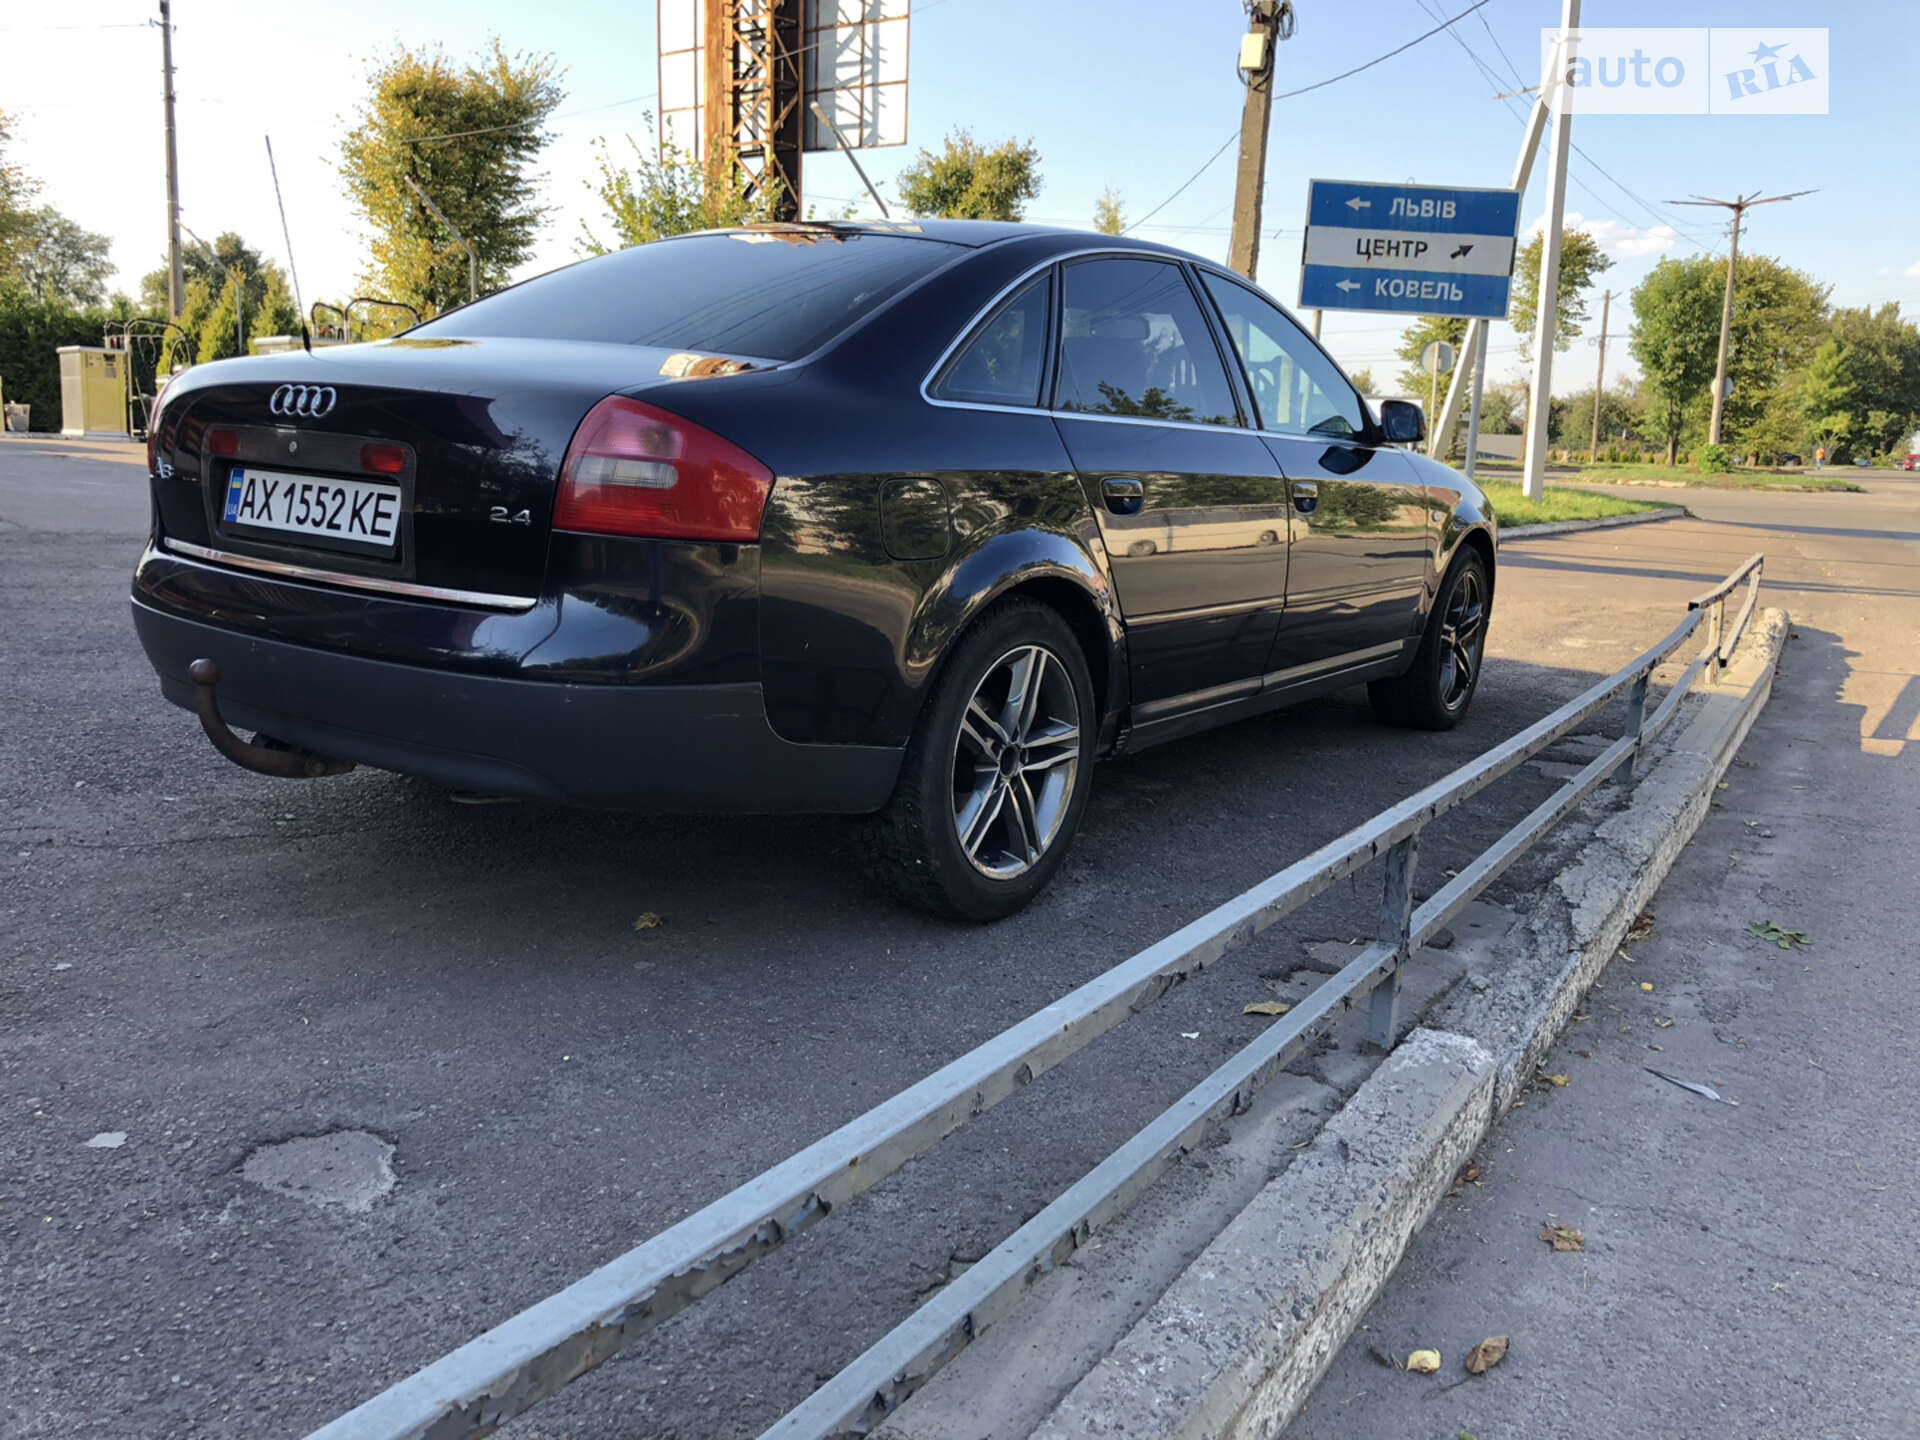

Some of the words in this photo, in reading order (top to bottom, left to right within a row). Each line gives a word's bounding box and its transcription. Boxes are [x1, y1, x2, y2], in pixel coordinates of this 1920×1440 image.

[1389, 198, 1456, 219] ЛЬВІВ
[1356, 238, 1428, 259] ЦЕНТР
[1374, 278, 1464, 301] КОВЕЛЬ
